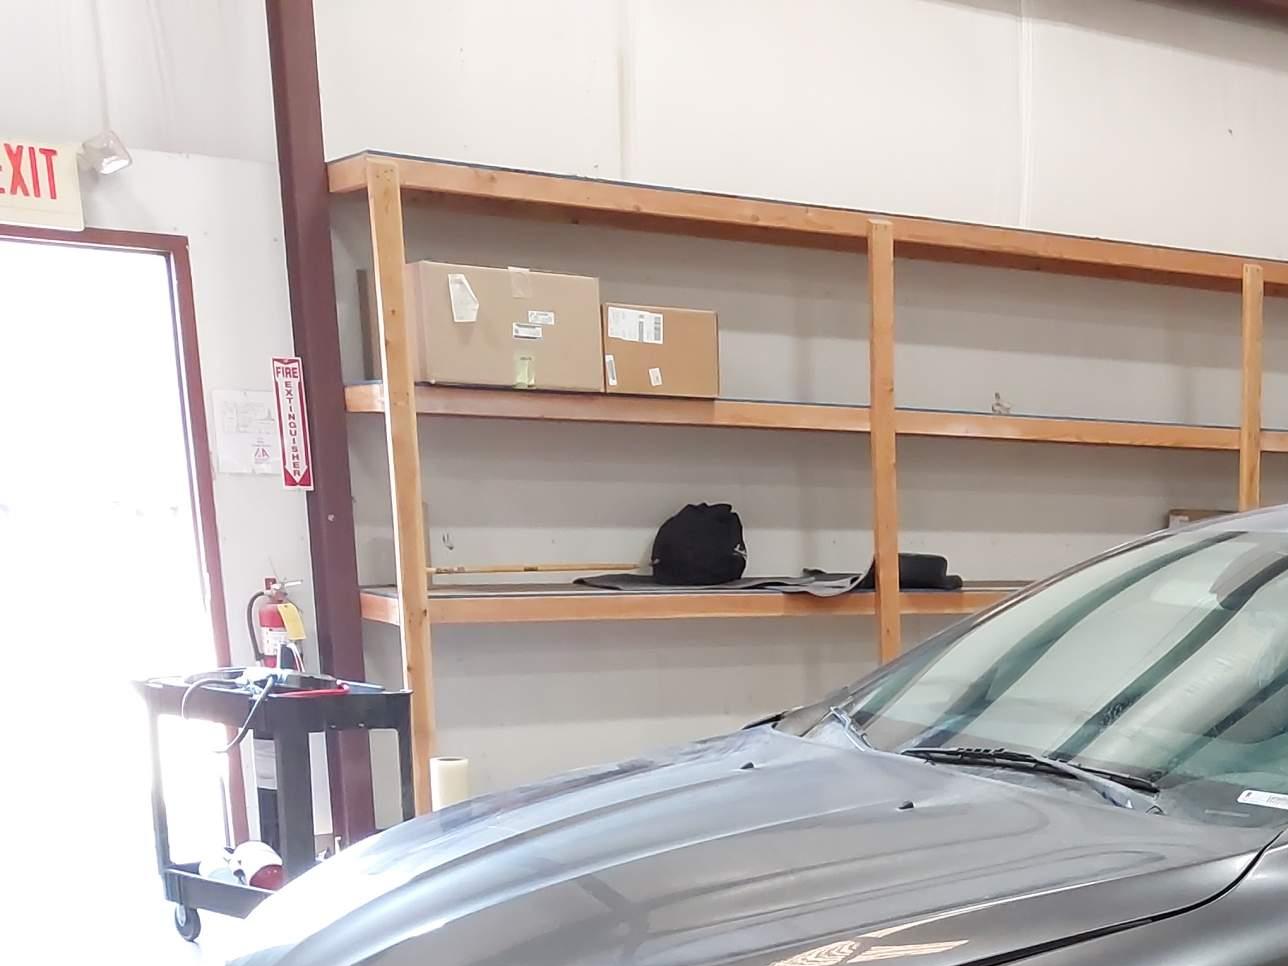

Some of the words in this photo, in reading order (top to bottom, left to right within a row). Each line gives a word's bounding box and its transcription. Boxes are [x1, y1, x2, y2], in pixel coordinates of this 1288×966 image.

[0, 143, 57, 200] XIT
[276, 366, 299, 379] FIRE
[284, 381, 301, 477] EXTINGUISHER
